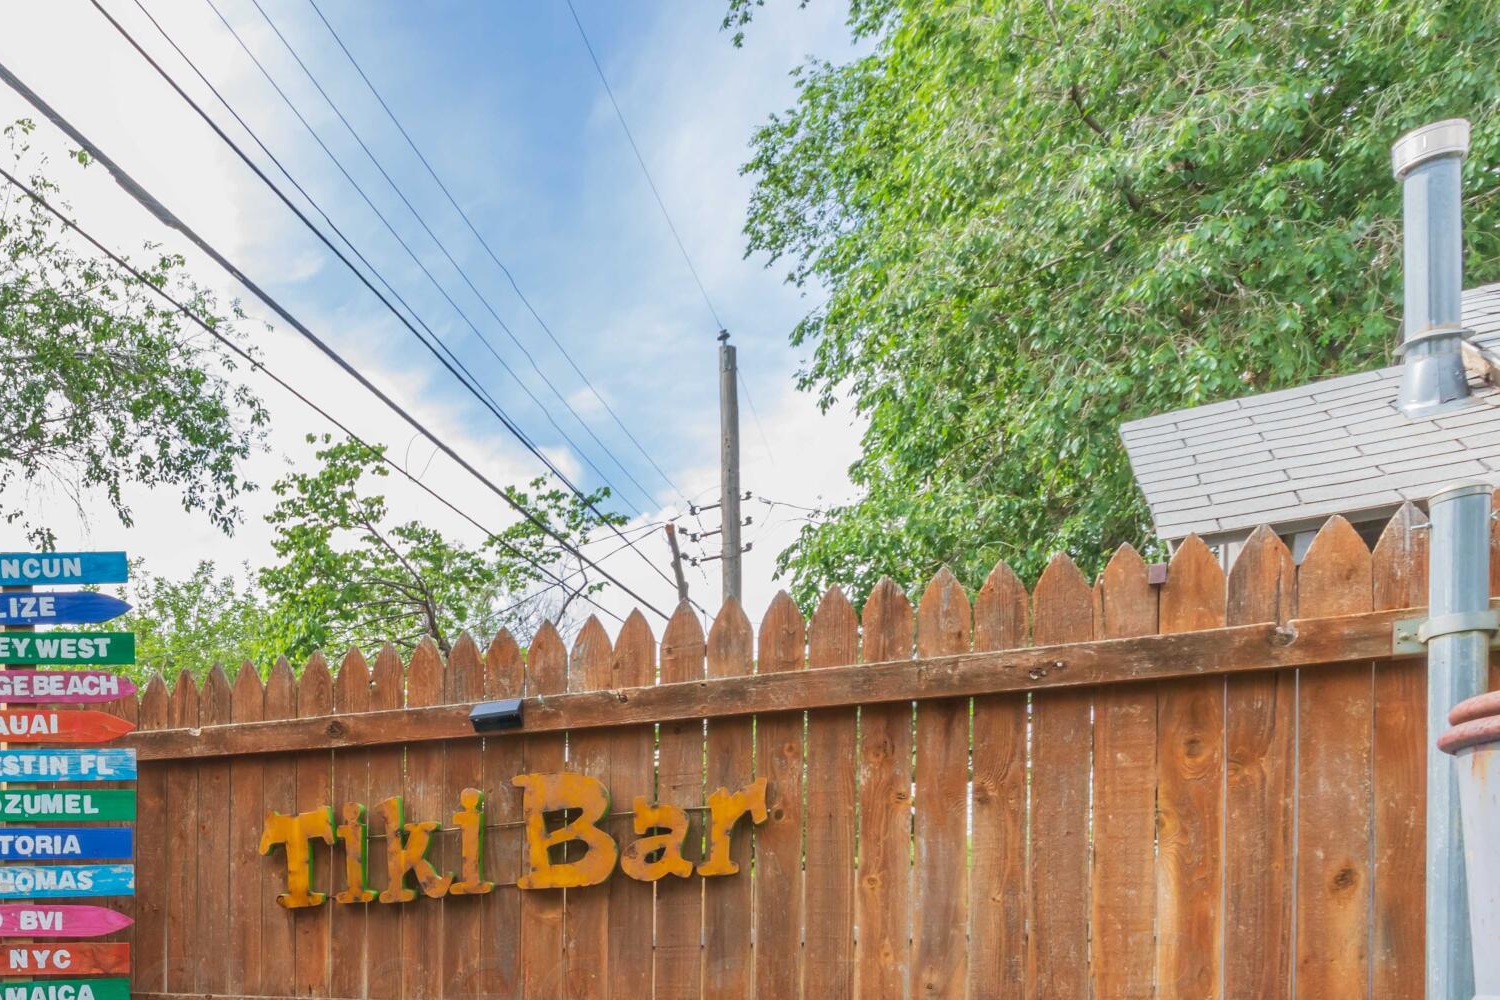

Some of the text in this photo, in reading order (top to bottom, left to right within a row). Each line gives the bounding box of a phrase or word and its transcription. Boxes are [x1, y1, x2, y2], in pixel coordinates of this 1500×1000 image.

[35, 637, 112, 659] WEST
[33, 675, 119, 696] BEACH
[80, 754, 114, 775] FL
[259, 771, 769, 909] Tiki Bar
[19, 910, 63, 931] BVI
[9, 949, 72, 970] NYC
